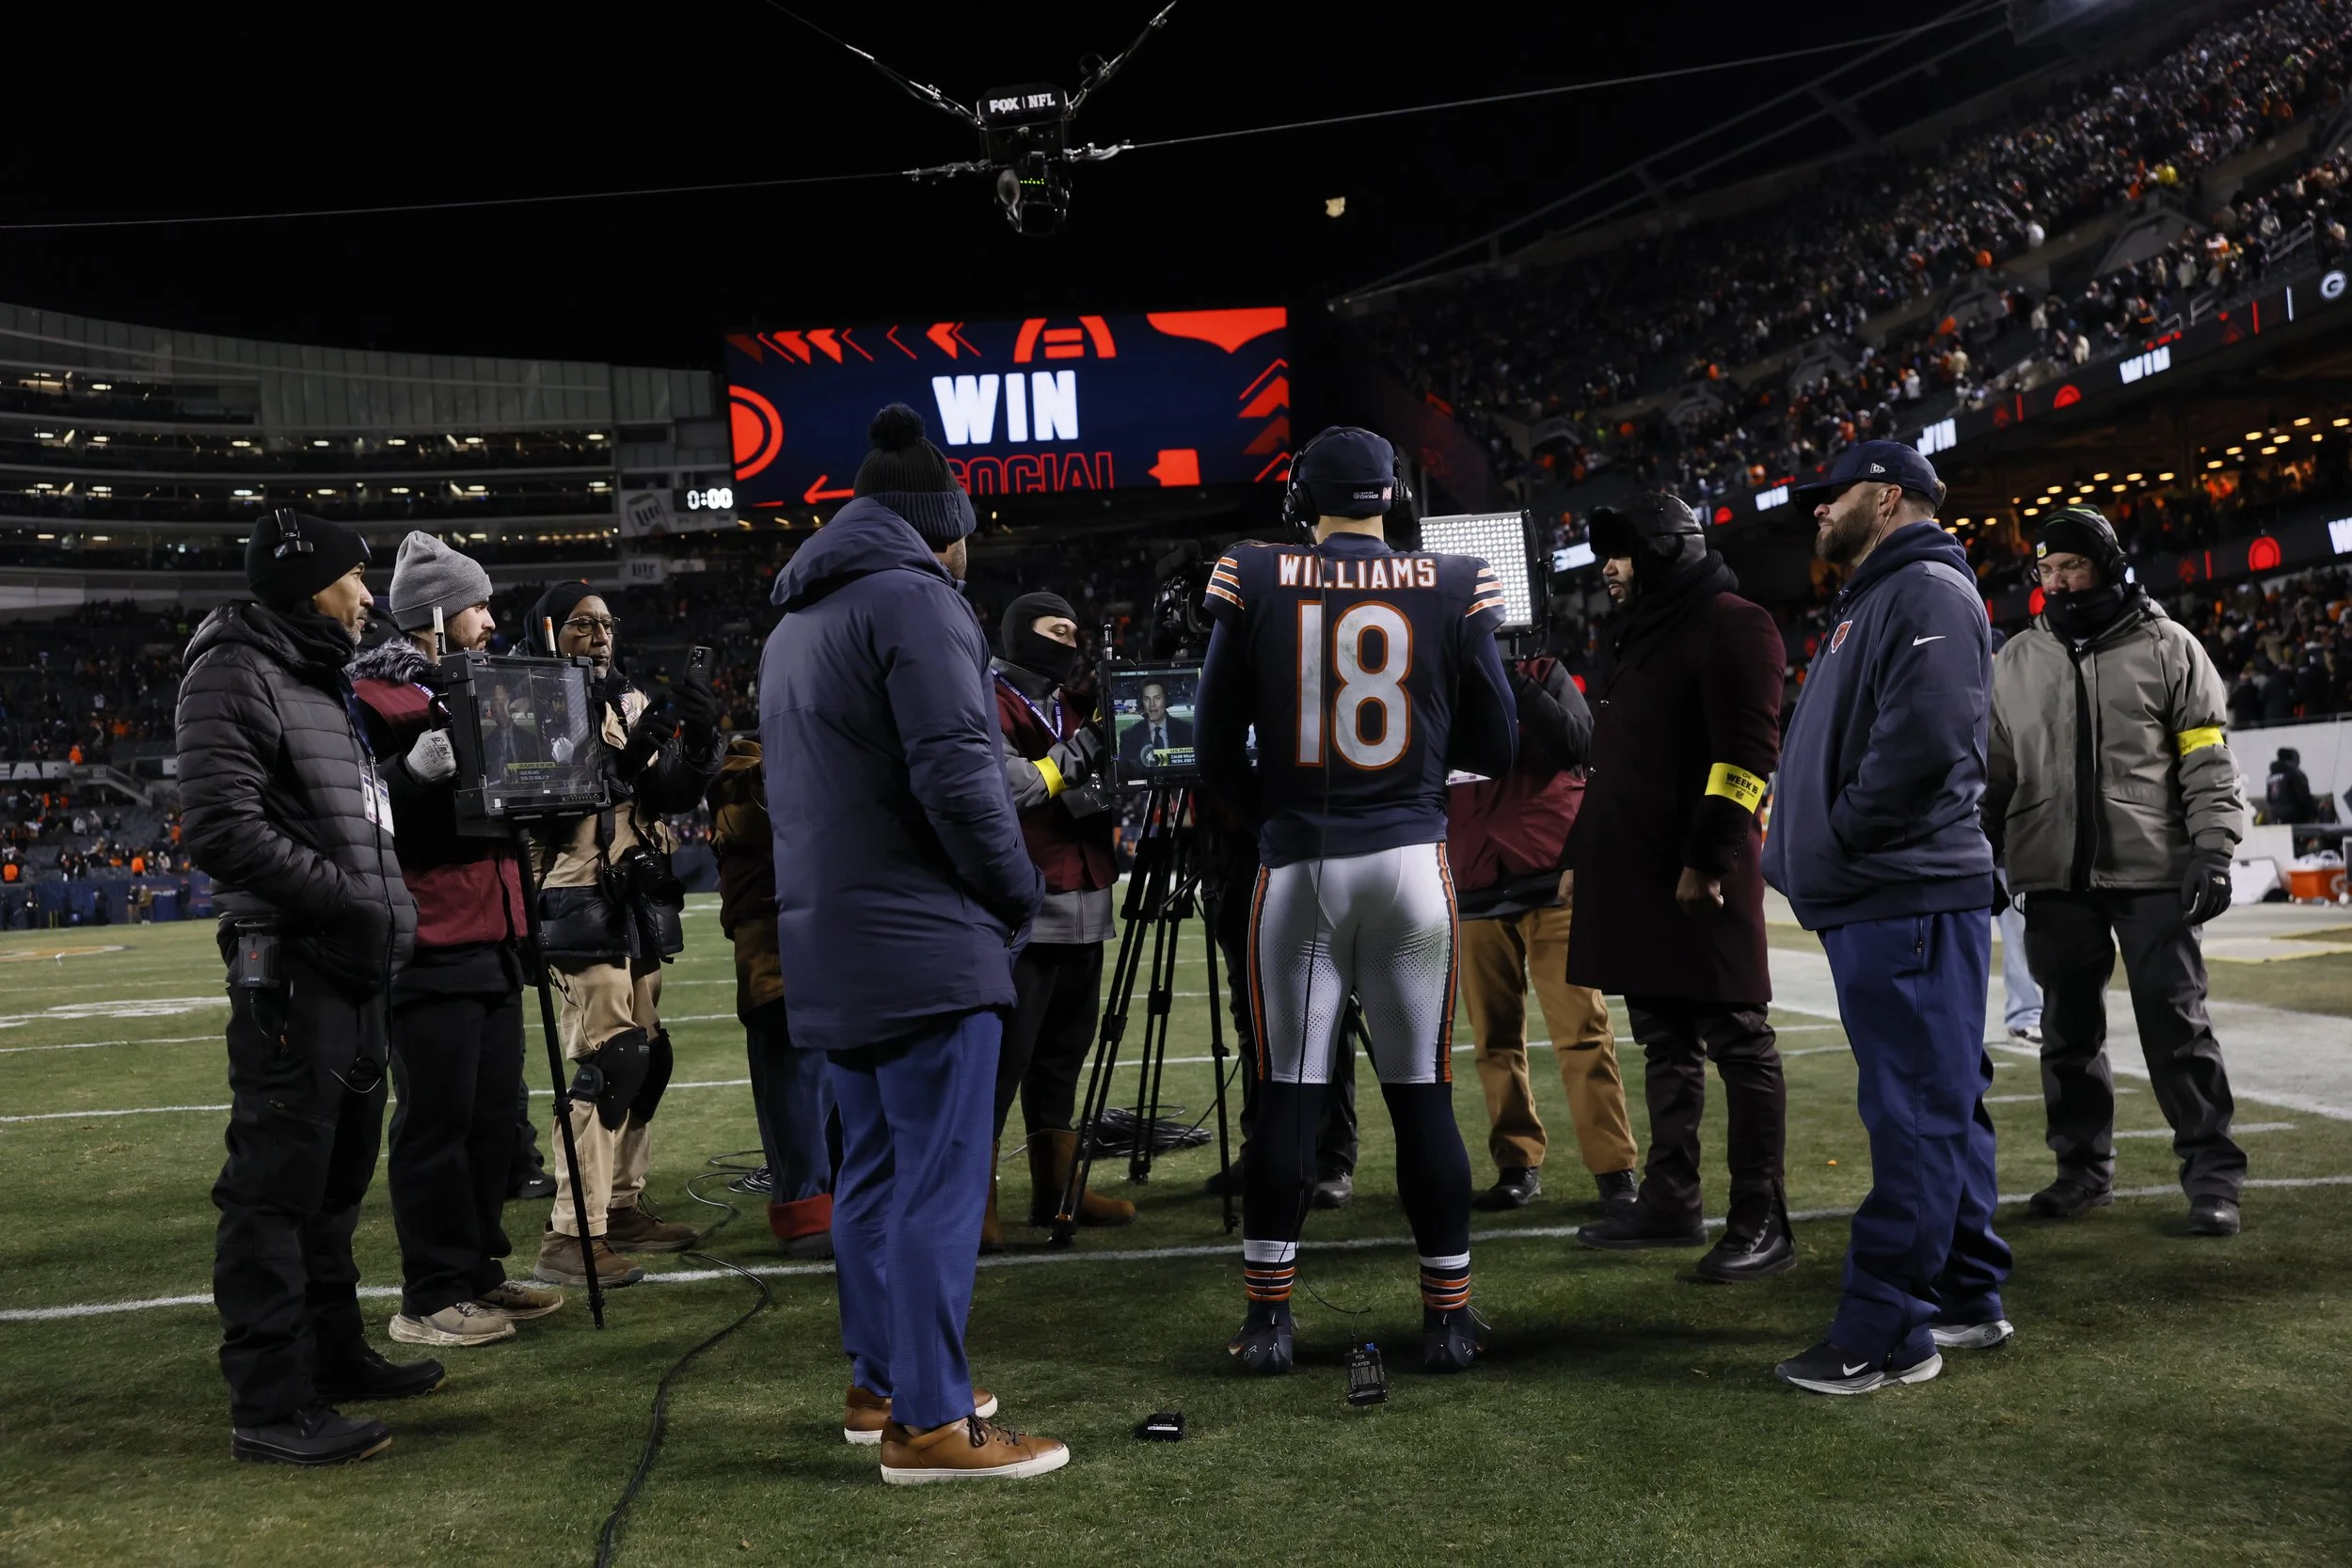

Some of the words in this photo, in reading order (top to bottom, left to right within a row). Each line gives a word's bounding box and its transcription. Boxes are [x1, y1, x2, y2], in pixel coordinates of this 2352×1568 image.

[989, 97, 1020, 115] FOX
[1027, 93, 1056, 109] NFL
[2119, 345, 2171, 385] WIN
[931, 370, 1079, 446] WIN
[687, 487, 734, 510] 0:00
[1279, 553, 1438, 590] WILLIAMS
[1295, 599, 1414, 771] 18
[1726, 772, 1752, 791] WEEK
